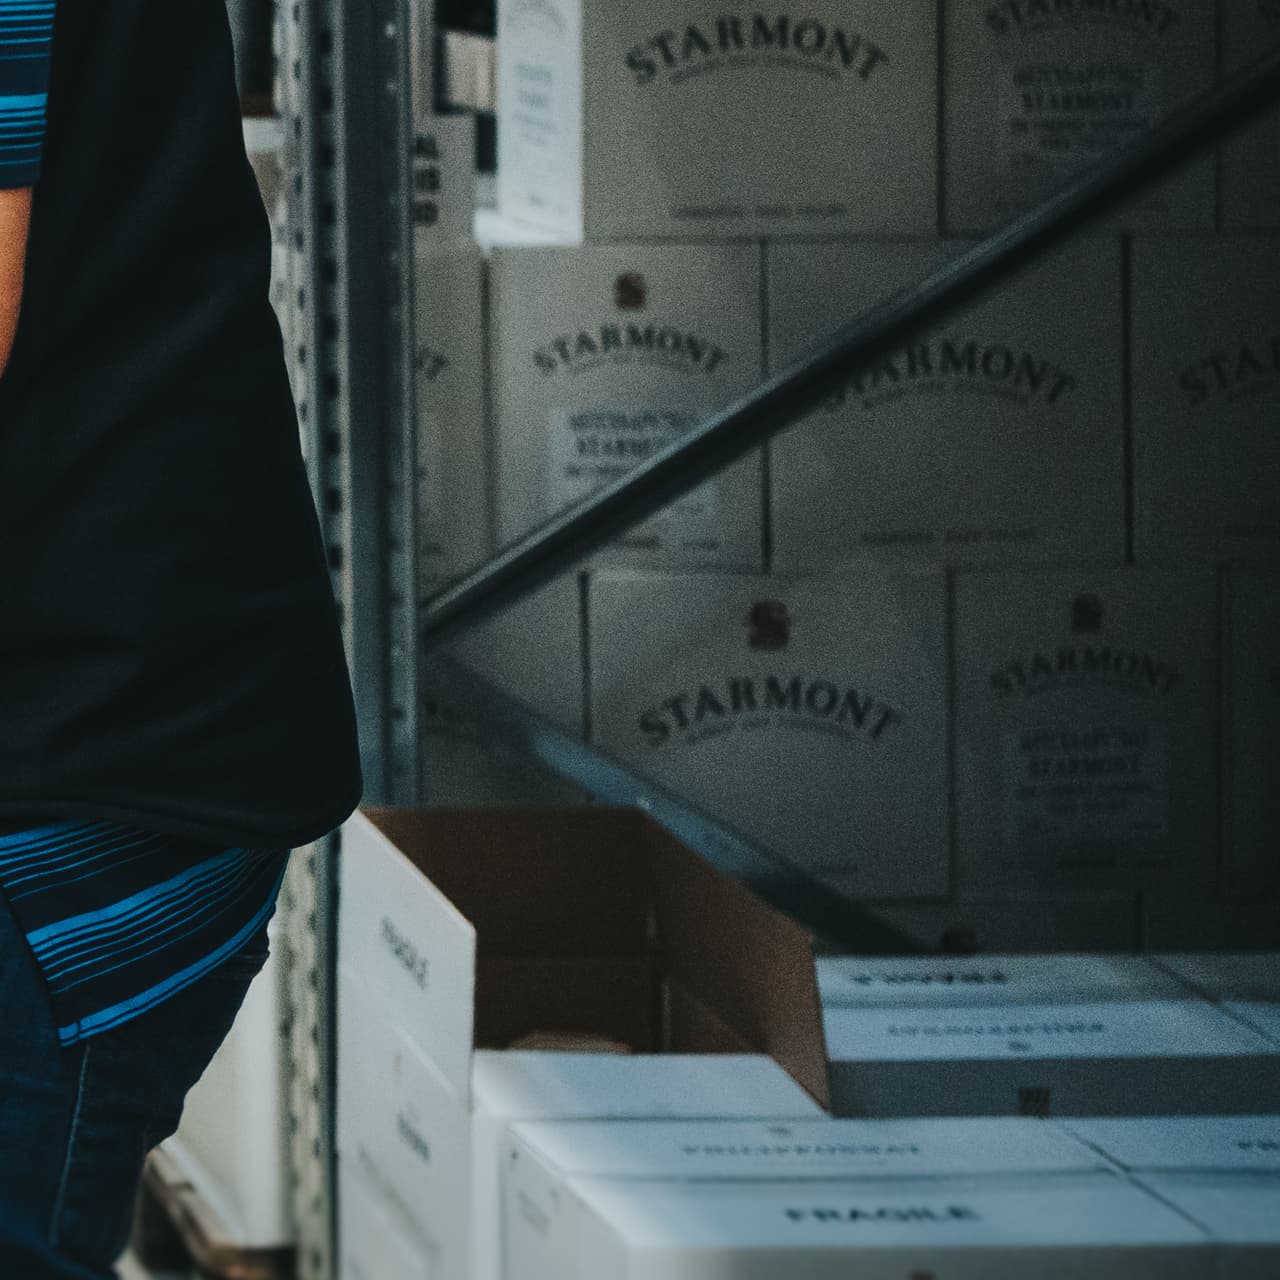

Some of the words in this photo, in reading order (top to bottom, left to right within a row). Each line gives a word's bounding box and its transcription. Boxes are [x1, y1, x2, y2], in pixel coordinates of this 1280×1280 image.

[625, 12, 890, 84] STARMONT
[534, 324, 730, 373] STARMONT
[638, 675, 903, 749] STARMONT
